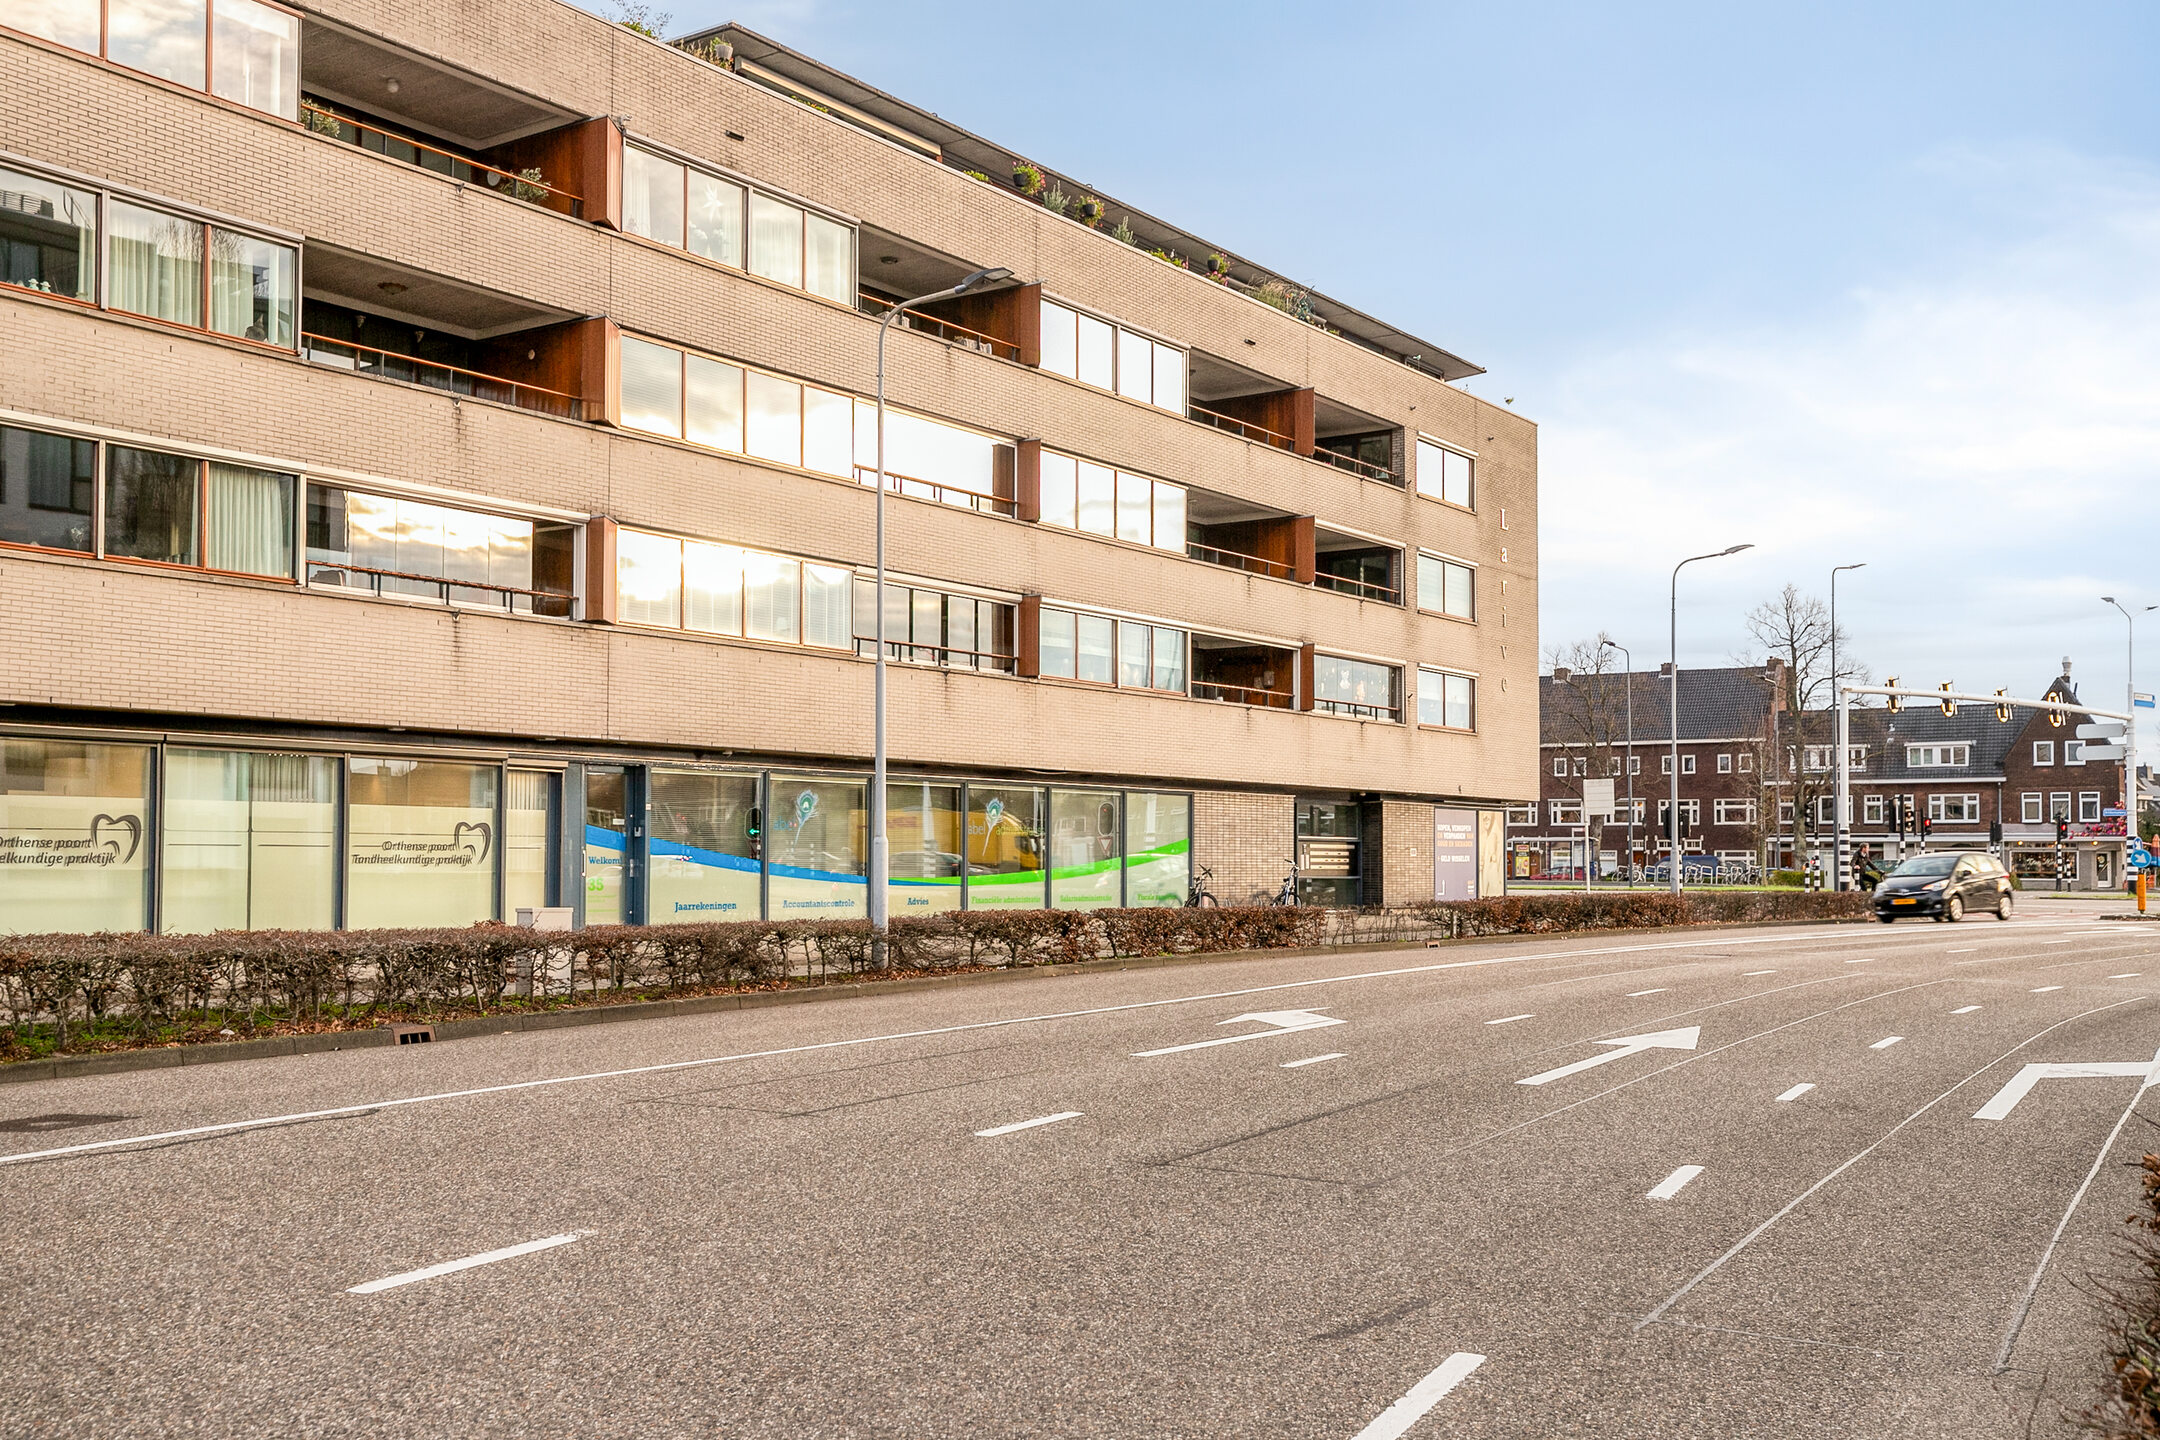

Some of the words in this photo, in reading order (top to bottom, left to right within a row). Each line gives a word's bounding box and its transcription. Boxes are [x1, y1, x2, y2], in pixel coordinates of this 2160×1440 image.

[968, 821, 986, 835] abel
[54, 838, 92, 851] poort
[382, 841, 427, 851] Orthense
[428, 843, 456, 853] poort
[64, 852, 116, 867] praktijk
[351, 854, 435, 867] Tandheelkundige
[435, 855, 473, 867] praktijk
[588, 856, 623, 864] Welkom!
[587, 878, 604, 891] 35
[674, 901, 737, 913] Jaarrekeningen
[783, 899, 855, 908] Accountantscontrole
[907, 898, 929, 906] Advies
